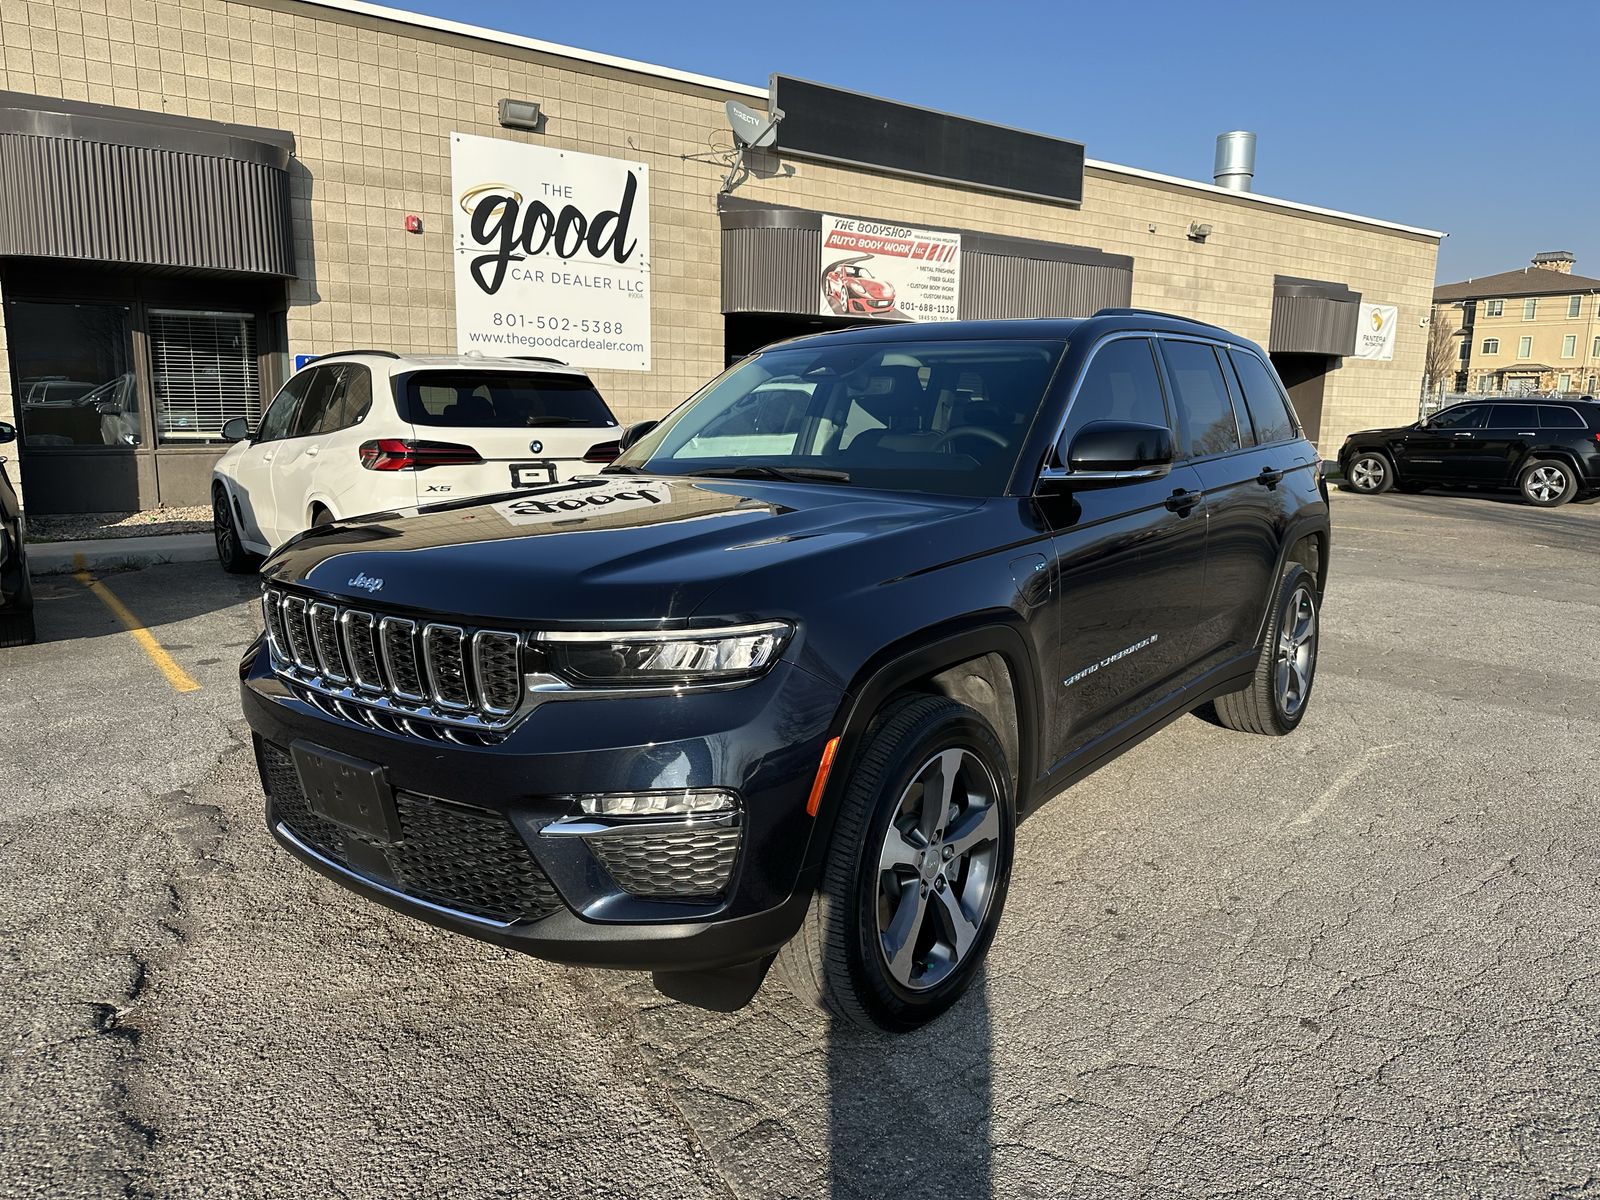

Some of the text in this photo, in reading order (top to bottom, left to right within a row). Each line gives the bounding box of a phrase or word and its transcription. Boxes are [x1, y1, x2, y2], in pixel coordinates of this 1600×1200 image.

[541, 183, 573, 199] THE
[470, 170, 638, 295] good
[834, 219, 912, 239] THE BODYSHOP
[829, 234, 926, 255] AUTO BODY WORK LLC
[511, 268, 644, 293] CAR DEALER LLC
[935, 267, 956, 275] FINISHING
[900, 301, 955, 314] 801-688-1130
[493, 312, 623, 335] 801-502-5388
[469, 331, 644, 353] www.thegoodcardealer.com
[347, 572, 385, 593] Jeep
